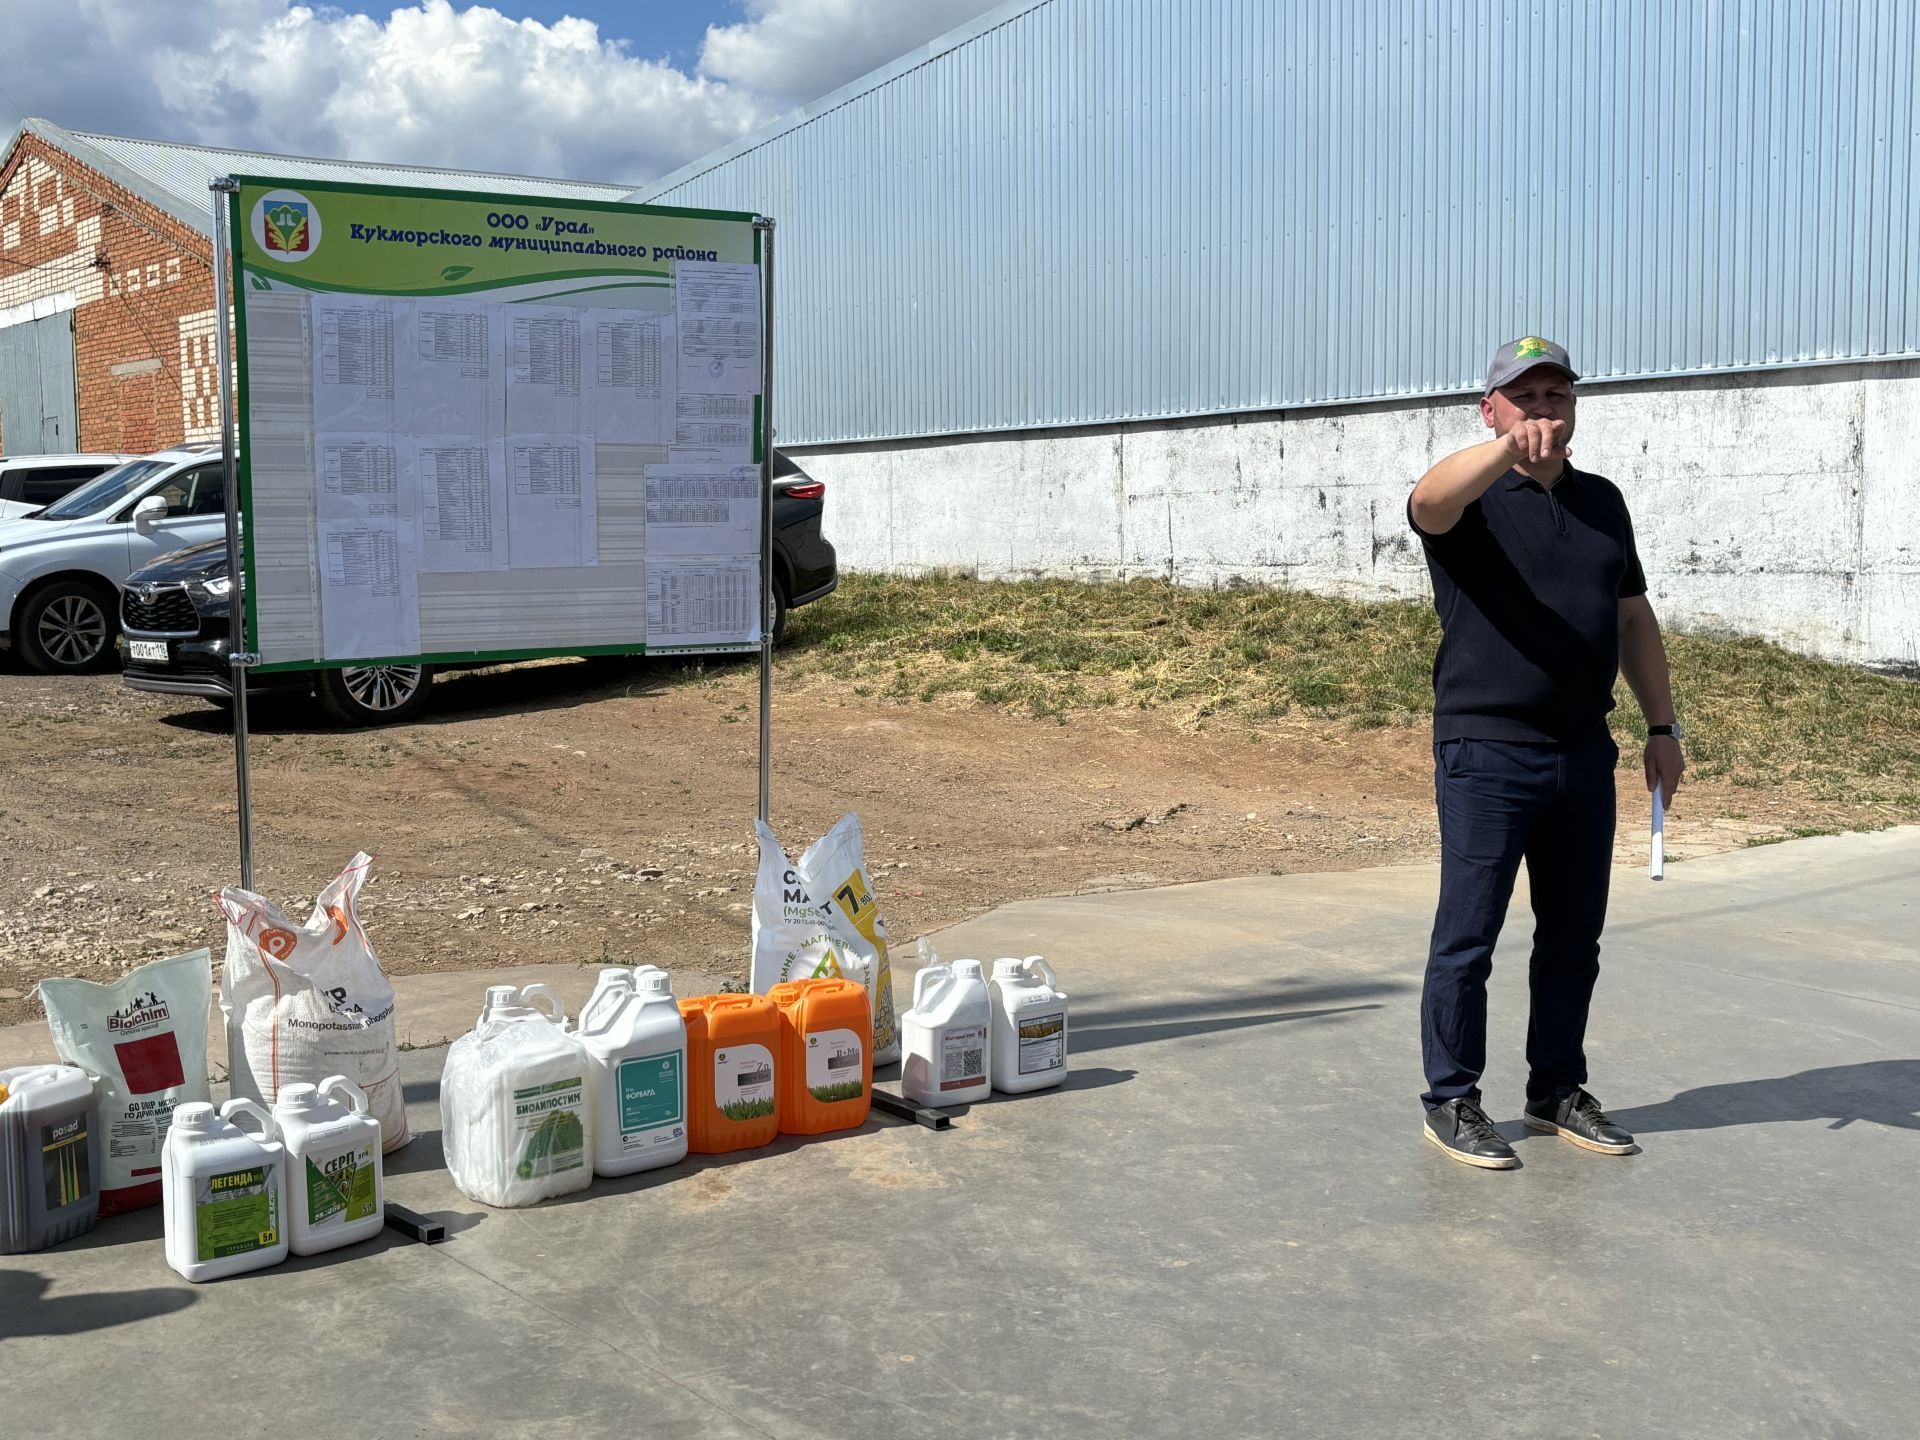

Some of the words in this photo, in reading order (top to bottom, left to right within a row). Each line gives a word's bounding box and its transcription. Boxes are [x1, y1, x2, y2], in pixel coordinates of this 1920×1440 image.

[487, 212, 528, 230] ООО
[535, 216, 595, 235] «Урал»
[350, 223, 483, 248] Кукморского
[488, 235, 647, 259] муниципального
[653, 244, 718, 262] района
[108, 1006, 169, 1030] Biolchim
[756, 1061, 769, 1072] Zn
[516, 1093, 581, 1115] БИОЛИПОСТИМ
[625, 1088, 656, 1101] ФОРВАРД
[124, 1111, 135, 1120] ГО
[128, 1102, 140, 1112] GO
[52, 1120, 78, 1141] posad
[325, 1150, 355, 1175] СЕРП
[211, 1172, 253, 1190] ЛЕГЕНДА
